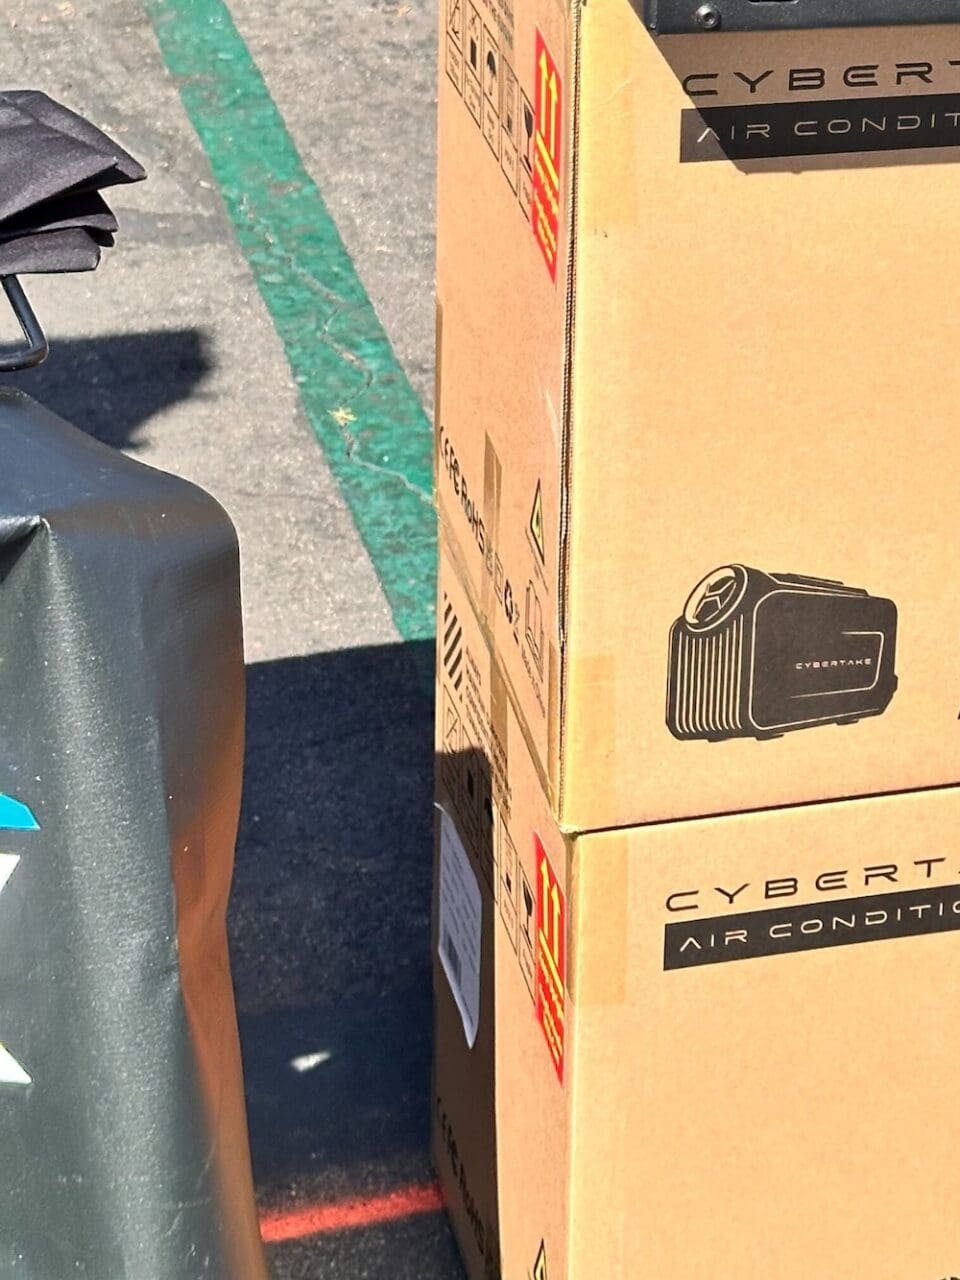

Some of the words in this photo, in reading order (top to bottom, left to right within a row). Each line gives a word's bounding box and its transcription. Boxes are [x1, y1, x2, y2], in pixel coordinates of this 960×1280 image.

[697, 123, 771, 143] AIR
[795, 658, 872, 670] CYBERTAKE
[680, 929, 748, 952] AIR
